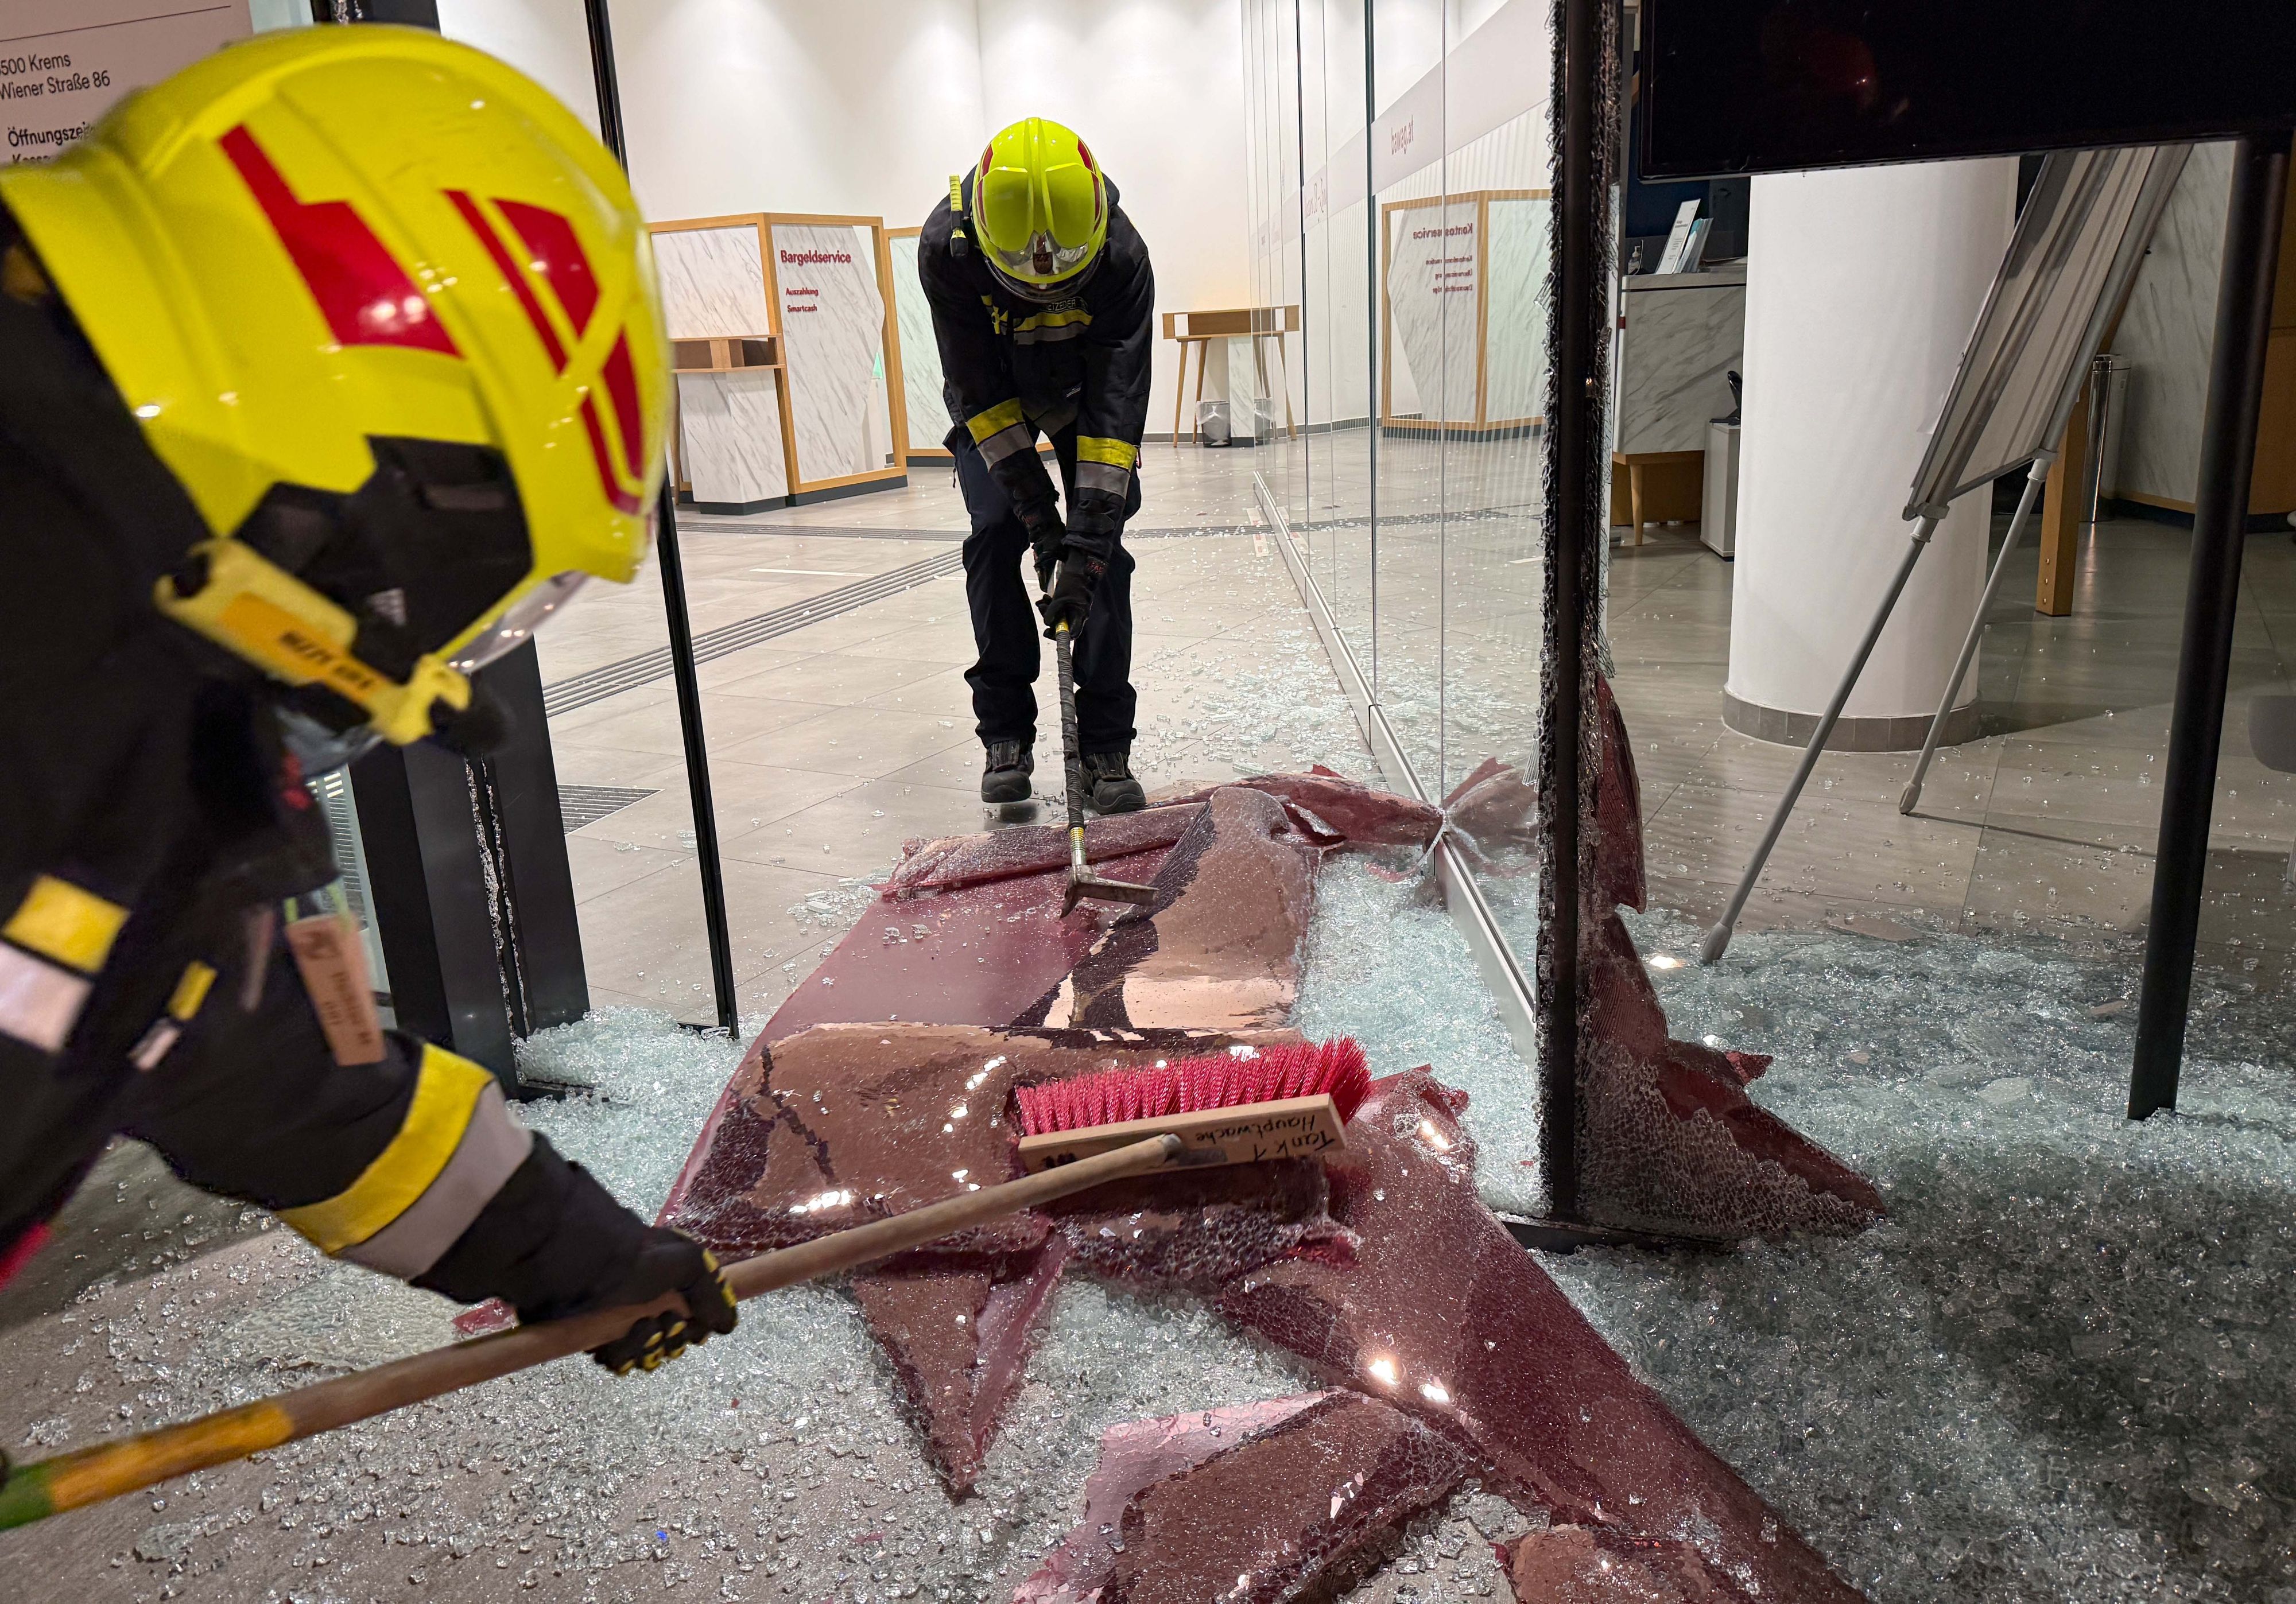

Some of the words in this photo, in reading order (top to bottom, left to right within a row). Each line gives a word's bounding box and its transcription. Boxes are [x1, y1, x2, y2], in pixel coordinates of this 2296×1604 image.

[0, 58, 26, 76] 500
[29, 54, 71, 72] Krems
[0, 81, 44, 100] Wiener
[47, 73, 90, 94] Straße
[93, 70, 110, 88] 86
[1391, 114, 1414, 155] bawag.at
[781, 250, 851, 266] Bargeldservice
[786, 287, 819, 297] Auszahlung
[787, 304, 817, 313] Smartcash
[1195, 1114, 1315, 1144] Hauptwache
[1277, 1131, 1335, 1158] Tank
